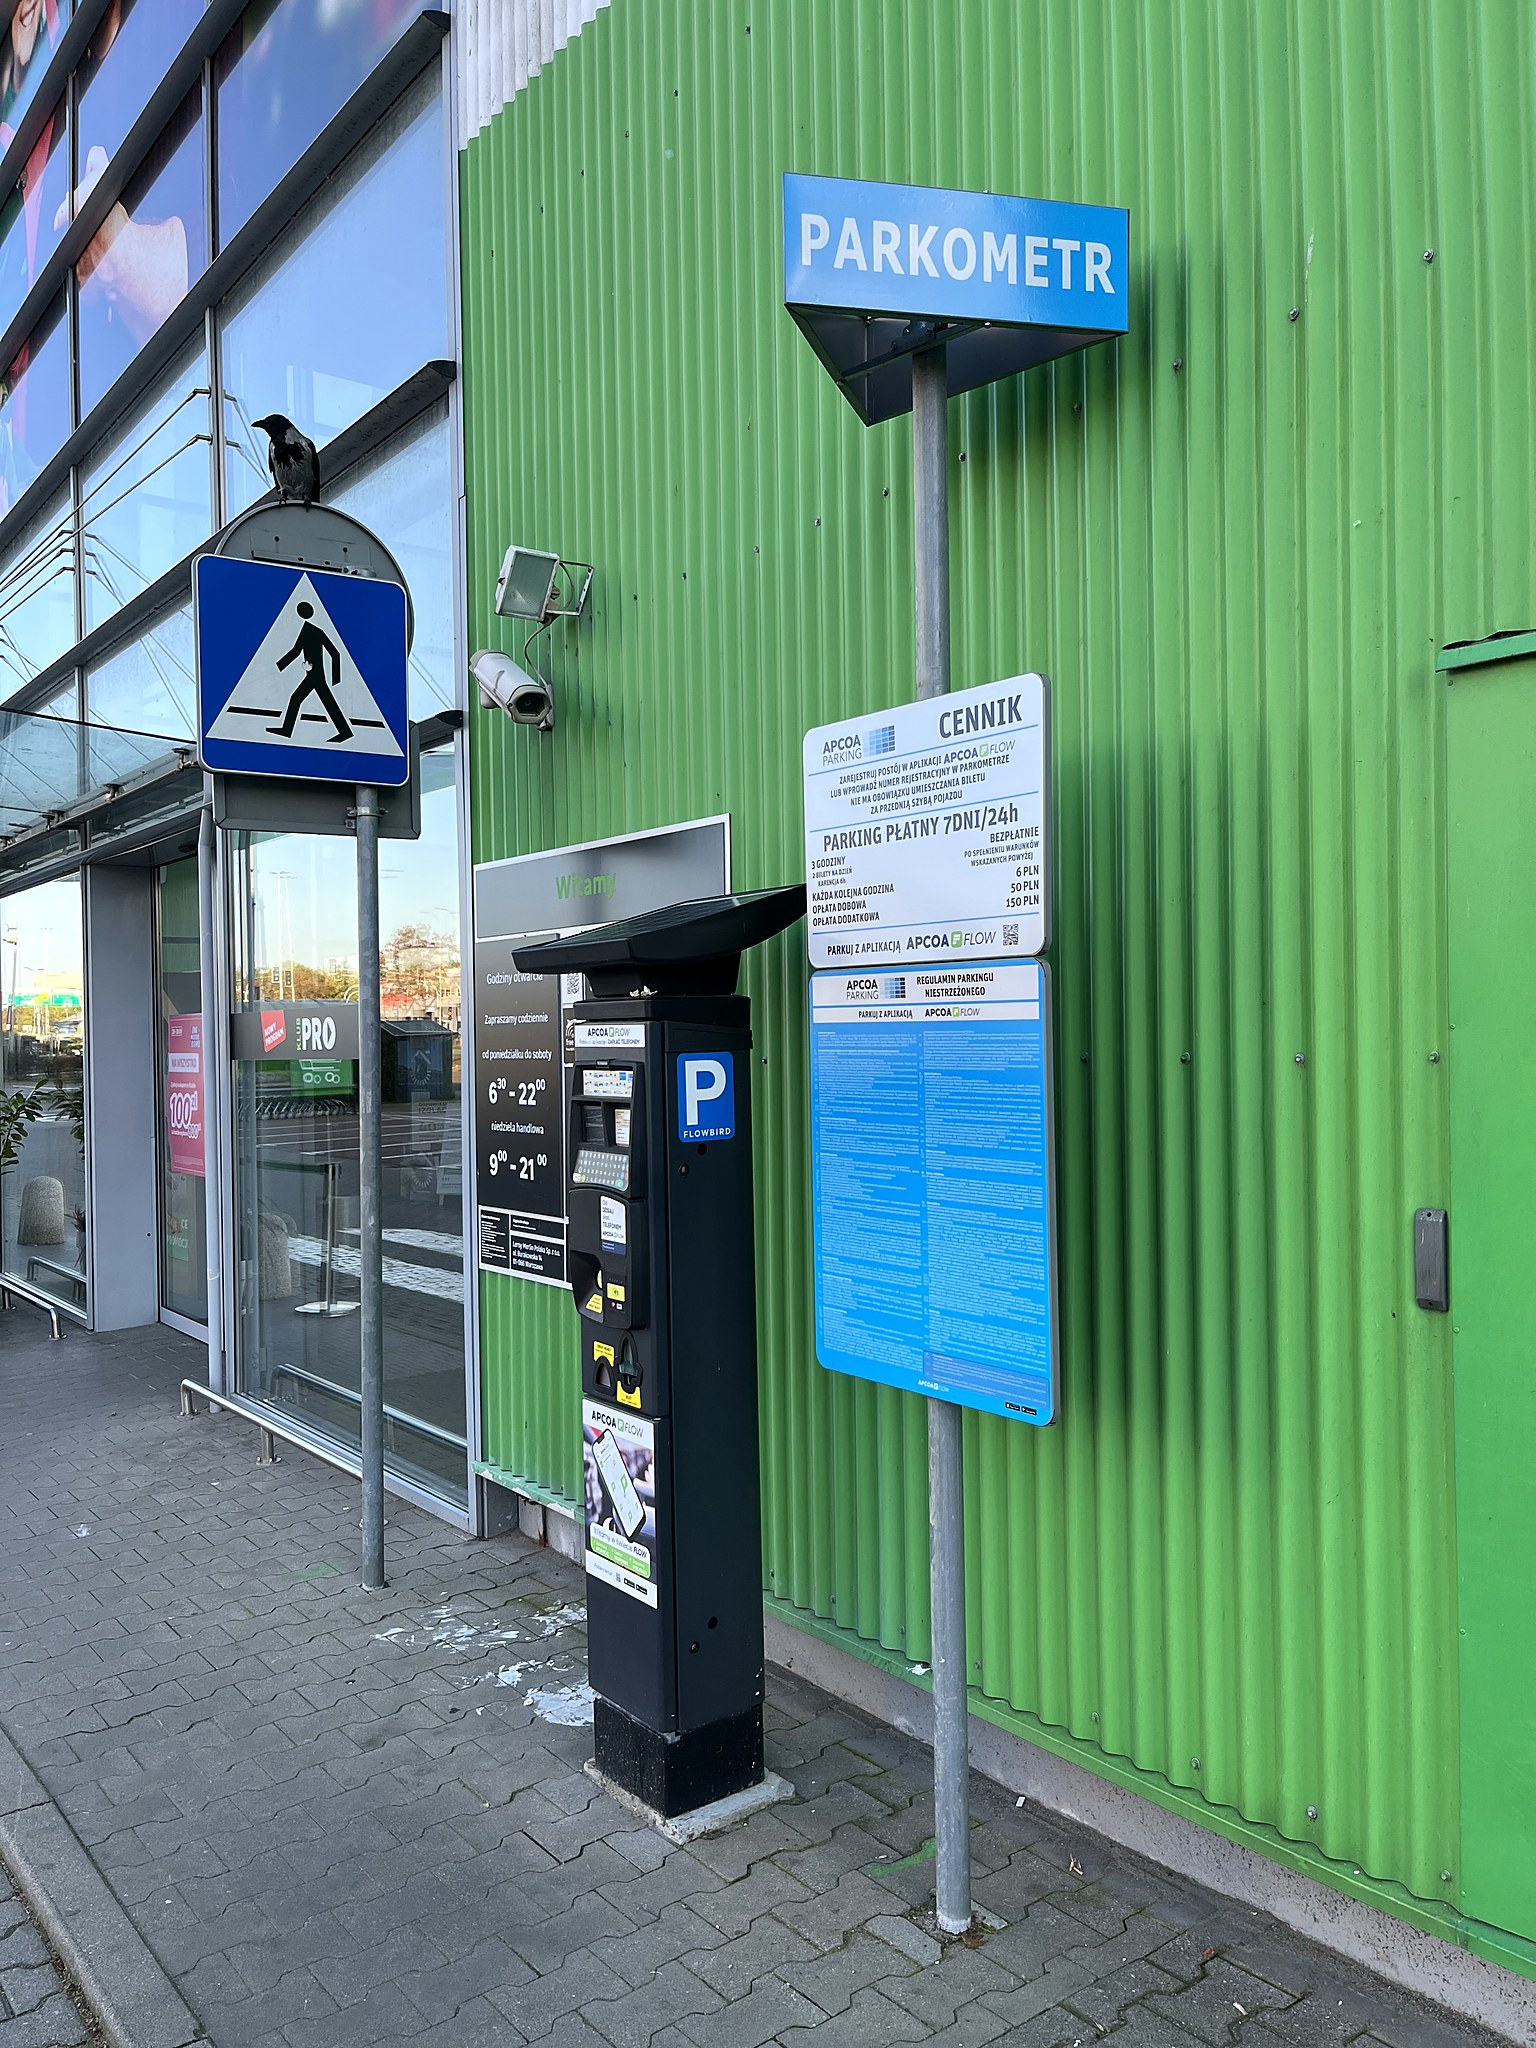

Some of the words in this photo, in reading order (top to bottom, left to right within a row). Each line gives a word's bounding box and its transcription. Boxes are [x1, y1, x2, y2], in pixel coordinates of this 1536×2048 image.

[801, 213, 1116, 294] PARKOMETR
[939, 695, 1023, 739] CENNIK
[823, 734, 862, 754] APCOA
[822, 748, 862, 767] PARKING
[839, 769, 877, 785] ZAREJESTRUJ
[878, 762, 901, 777] POSTÓJ
[901, 763, 909, 772] W
[909, 755, 942, 770] APLIKACJI
[943, 747, 979, 765] APCOA
[989, 740, 1016, 755] FLOW
[830, 788, 842, 798] LUB
[842, 780, 877, 796] WPROWADŹ
[878, 776, 900, 789] NUMER
[901, 766, 951, 784] REJESTRACYJNY
[951, 765, 959, 774] W
[959, 754, 1010, 773] PARKOMETRZE
[850, 798, 861, 806] NIE
[861, 794, 872, 804] MA
[872, 787, 910, 802] OBOWIĄZKU
[911, 778, 960, 795] UMIESZCZANIA
[961, 772, 986, 785] BILETU
[870, 805, 879, 814] ZA
[879, 799, 911, 813] PRZEDNIĄ
[911, 796, 933, 807] SZYBĄ
[933, 790, 963, 803] POJAZDU
[823, 826, 882, 852] PARKING
[886, 816, 940, 843] PŁATNY
[943, 802, 1018, 835] 7DNI/24h
[990, 826, 1039, 843] BEZPŁATNIE
[964, 849, 972, 858] PO
[972, 844, 1005, 857] SPEŁNIENIU
[1006, 840, 1040, 852] WARUNKÓW
[811, 860, 816, 870] 3
[816, 856, 846, 869] GODZINY
[970, 855, 1007, 867] WSKAZANYCH
[1008, 851, 1034, 863] POWYŻEJ
[816, 870, 831, 878] BILETY
[831, 869, 838, 877] NA
[838, 866, 853, 876] DZIEŃ
[1016, 866, 1022, 877] 6
[1023, 864, 1039, 876] PLN
[555, 872, 617, 901] Witamy
[818, 878, 840, 887] KARENCJA
[1010, 882, 1022, 893] 50
[1023, 880, 1039, 891] PLN
[812, 889, 834, 901] KAŻDA
[834, 887, 863, 899] KOLEJNA
[863, 883, 895, 896] GODZINA
[812, 903, 837, 914] OPŁATA
[837, 900, 867, 912] DOBOWA
[1006, 897, 1022, 908] 150
[1023, 894, 1039, 906] PLN
[812, 916, 837, 927] OPŁATA
[837, 911, 880, 925] DODATKOWA
[827, 943, 854, 956] PARKUJ
[855, 943, 860, 954] Z
[861, 940, 901, 954] APLIKACJĄ
[906, 933, 950, 950] APCOA
[963, 931, 997, 946] FLOW
[486, 972, 513, 986] Godziny
[846, 979, 878, 990] APCOA
[916, 974, 956, 985] REGULAMIN
[957, 972, 994, 983] PARKINGU
[846, 990, 879, 1000] PARKING
[925, 985, 986, 998] NIESTRZEŻONEGO
[484, 1014, 518, 1026] Zapraszamy
[518, 1011, 549, 1024] codziennie
[858, 1010, 878, 1019] PARKUJ
[879, 1010, 883, 1018] Z
[883, 1009, 913, 1019] APLIKACJĄ
[924, 1008, 952, 1017] APCOA
[960, 1007, 981, 1016] FLOW
[263, 1022, 277, 1036] NOWY
[265, 1026, 284, 1047] PROGRAM
[301, 1016, 337, 1051] PRO
[587, 1027, 609, 1037] APCOA
[614, 1027, 630, 1037] FLOW
[482, 1049, 489, 1059] od
[489, 1049, 524, 1061] poniedziałku
[524, 1049, 532, 1059] do
[532, 1049, 552, 1061] soboty
[685, 1060, 727, 1126] P
[491, 1120, 516, 1132] niedziela
[516, 1122, 545, 1134] handlowa
[683, 1127, 731, 1139] FLOWBIRD
[591, 1410, 617, 1429] APCOA
[624, 1422, 644, 1438] FLOW
[633, 1546, 648, 1559] FLOW
